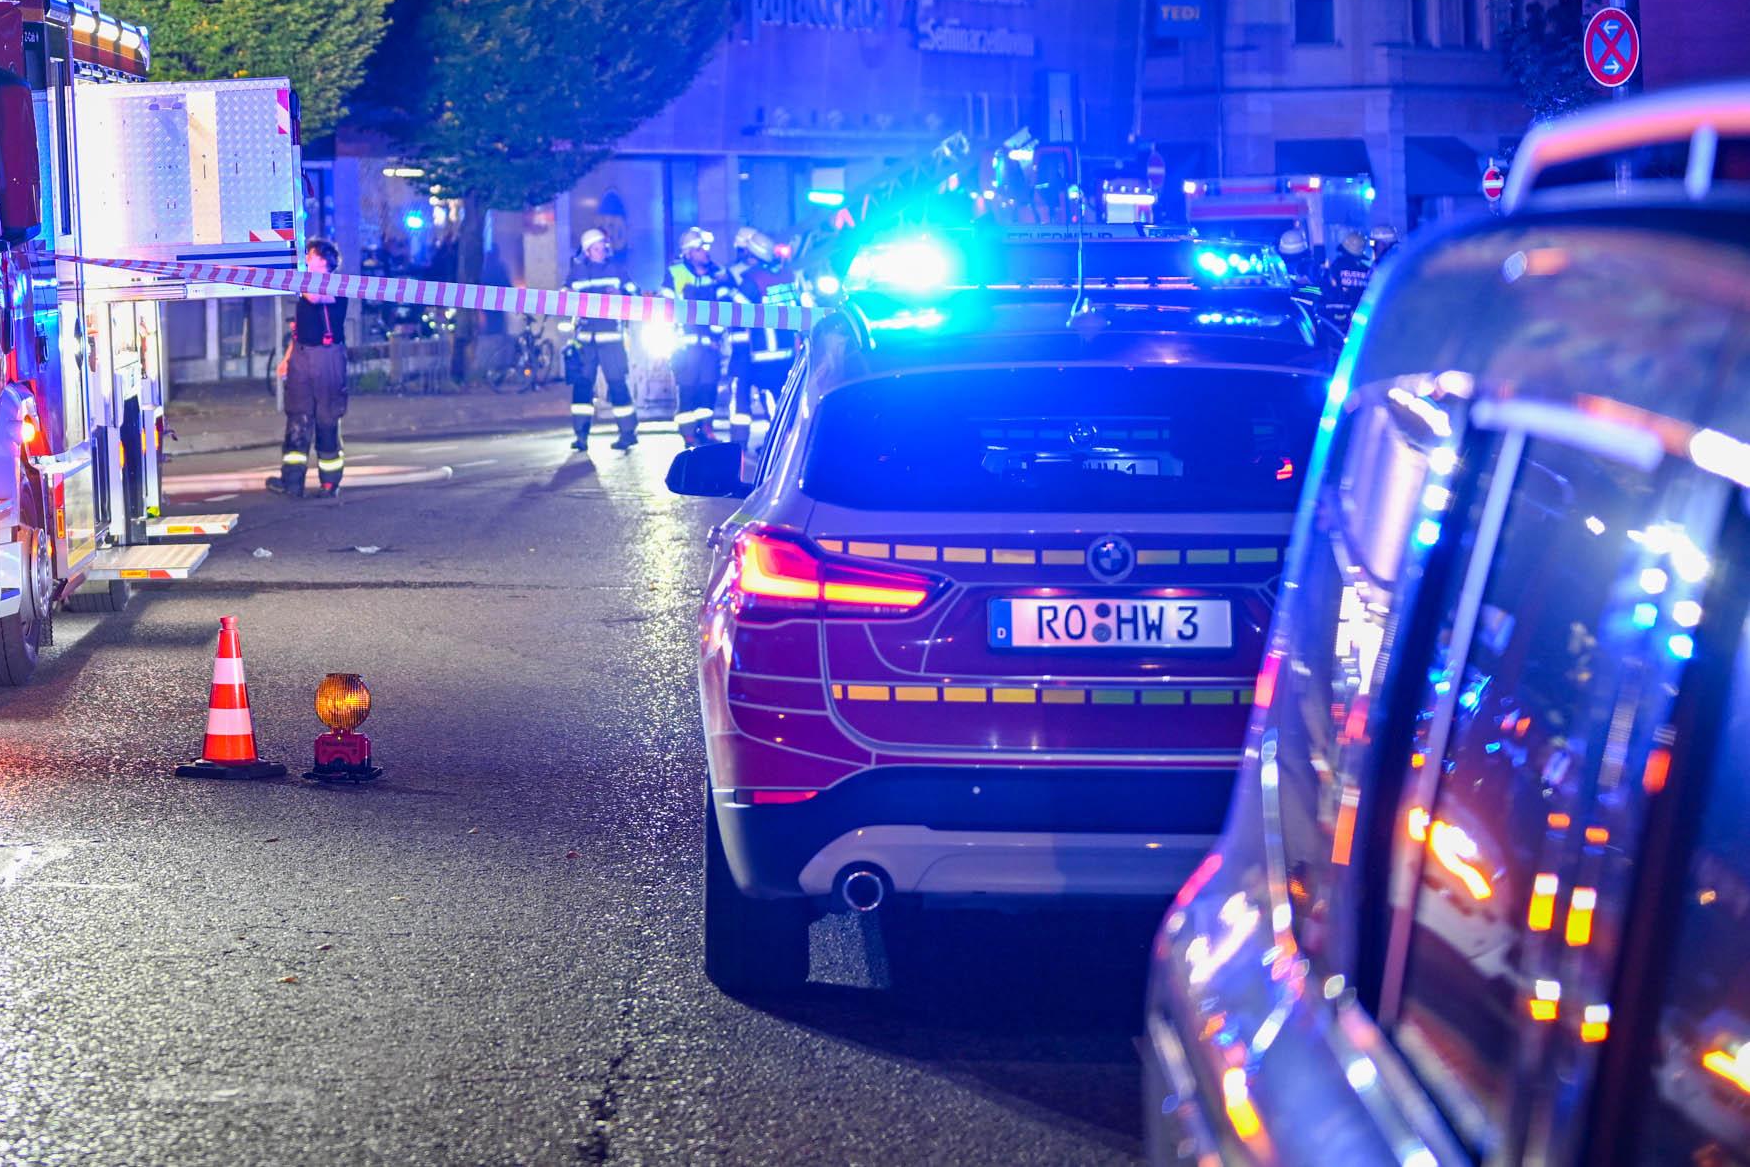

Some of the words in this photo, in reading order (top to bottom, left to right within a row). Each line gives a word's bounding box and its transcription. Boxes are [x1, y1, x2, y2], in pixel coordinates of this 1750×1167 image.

[1037, 605, 1086, 640] RO
[1116, 605, 1164, 639] HW
[1177, 605, 1199, 640] 3
